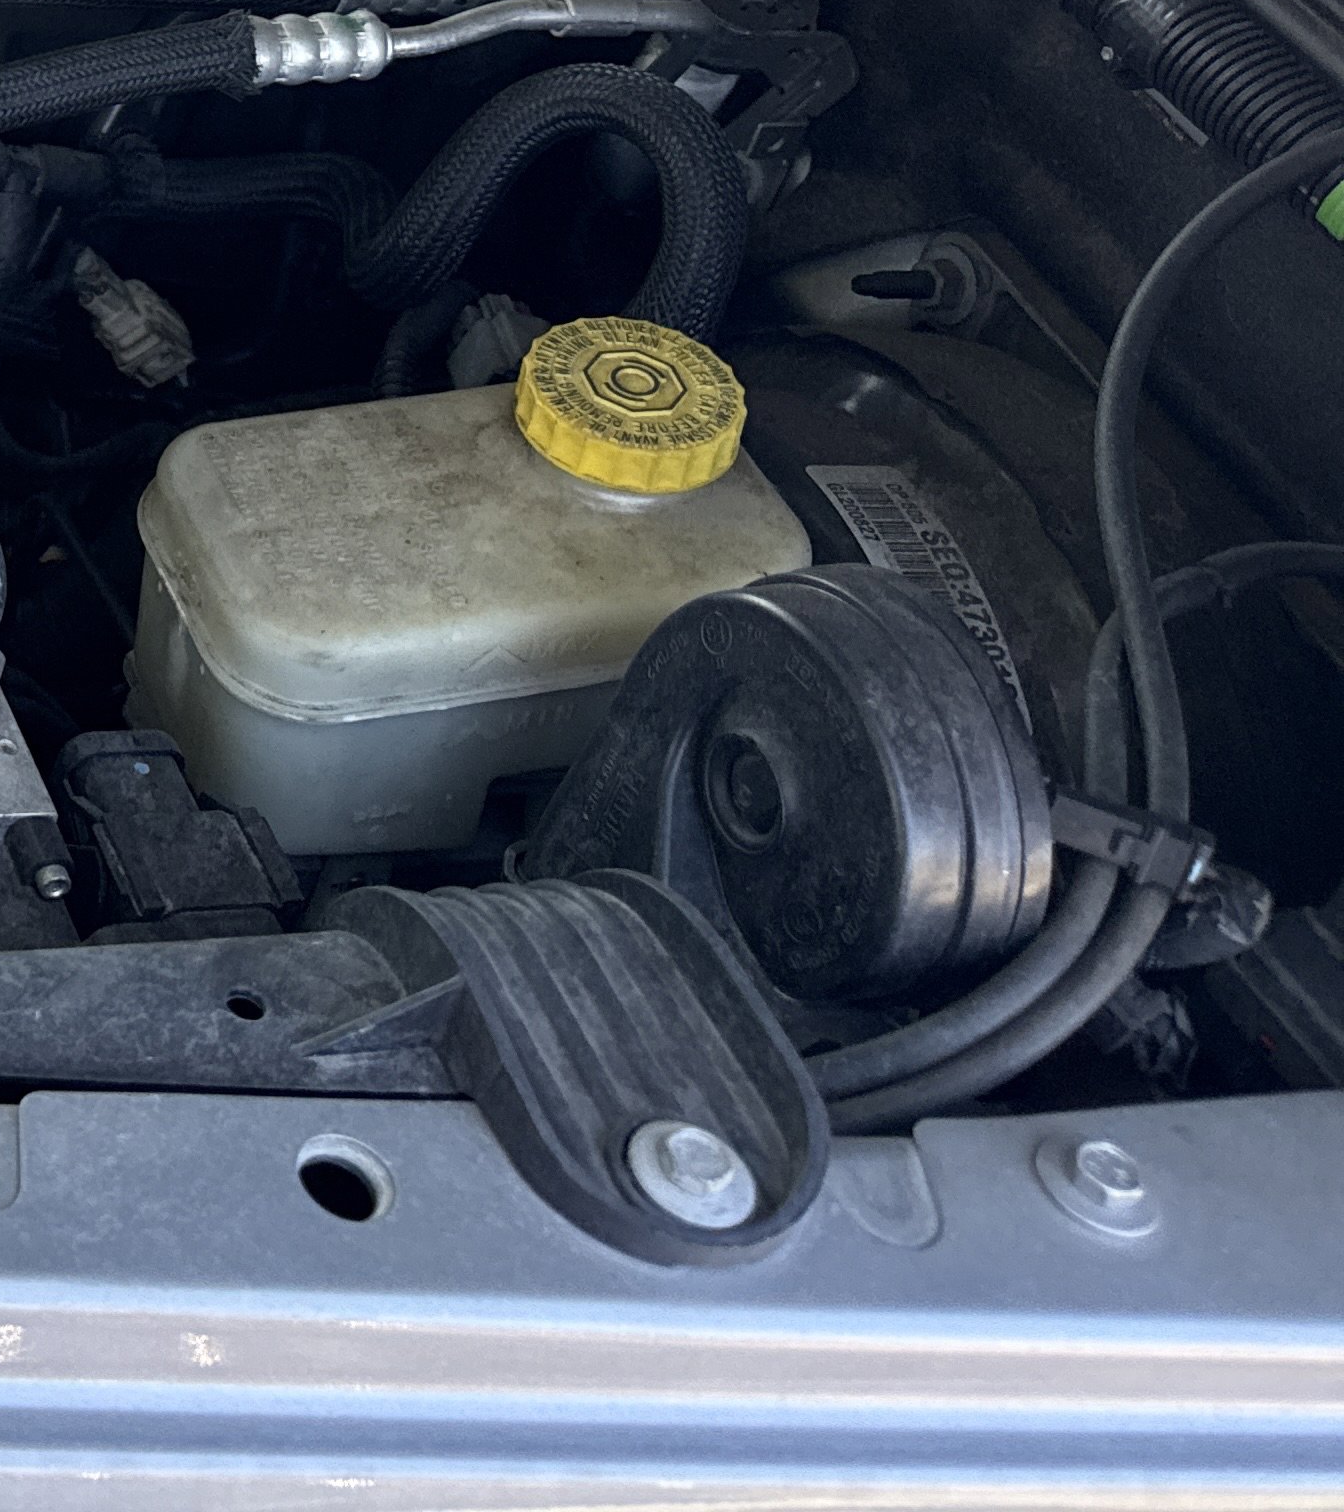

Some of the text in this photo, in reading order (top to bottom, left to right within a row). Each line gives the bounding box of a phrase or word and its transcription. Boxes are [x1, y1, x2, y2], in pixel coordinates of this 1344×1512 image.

[556, 331, 716, 435] WARNING CLEAN FILLER CAP BEFORE REMOVING
